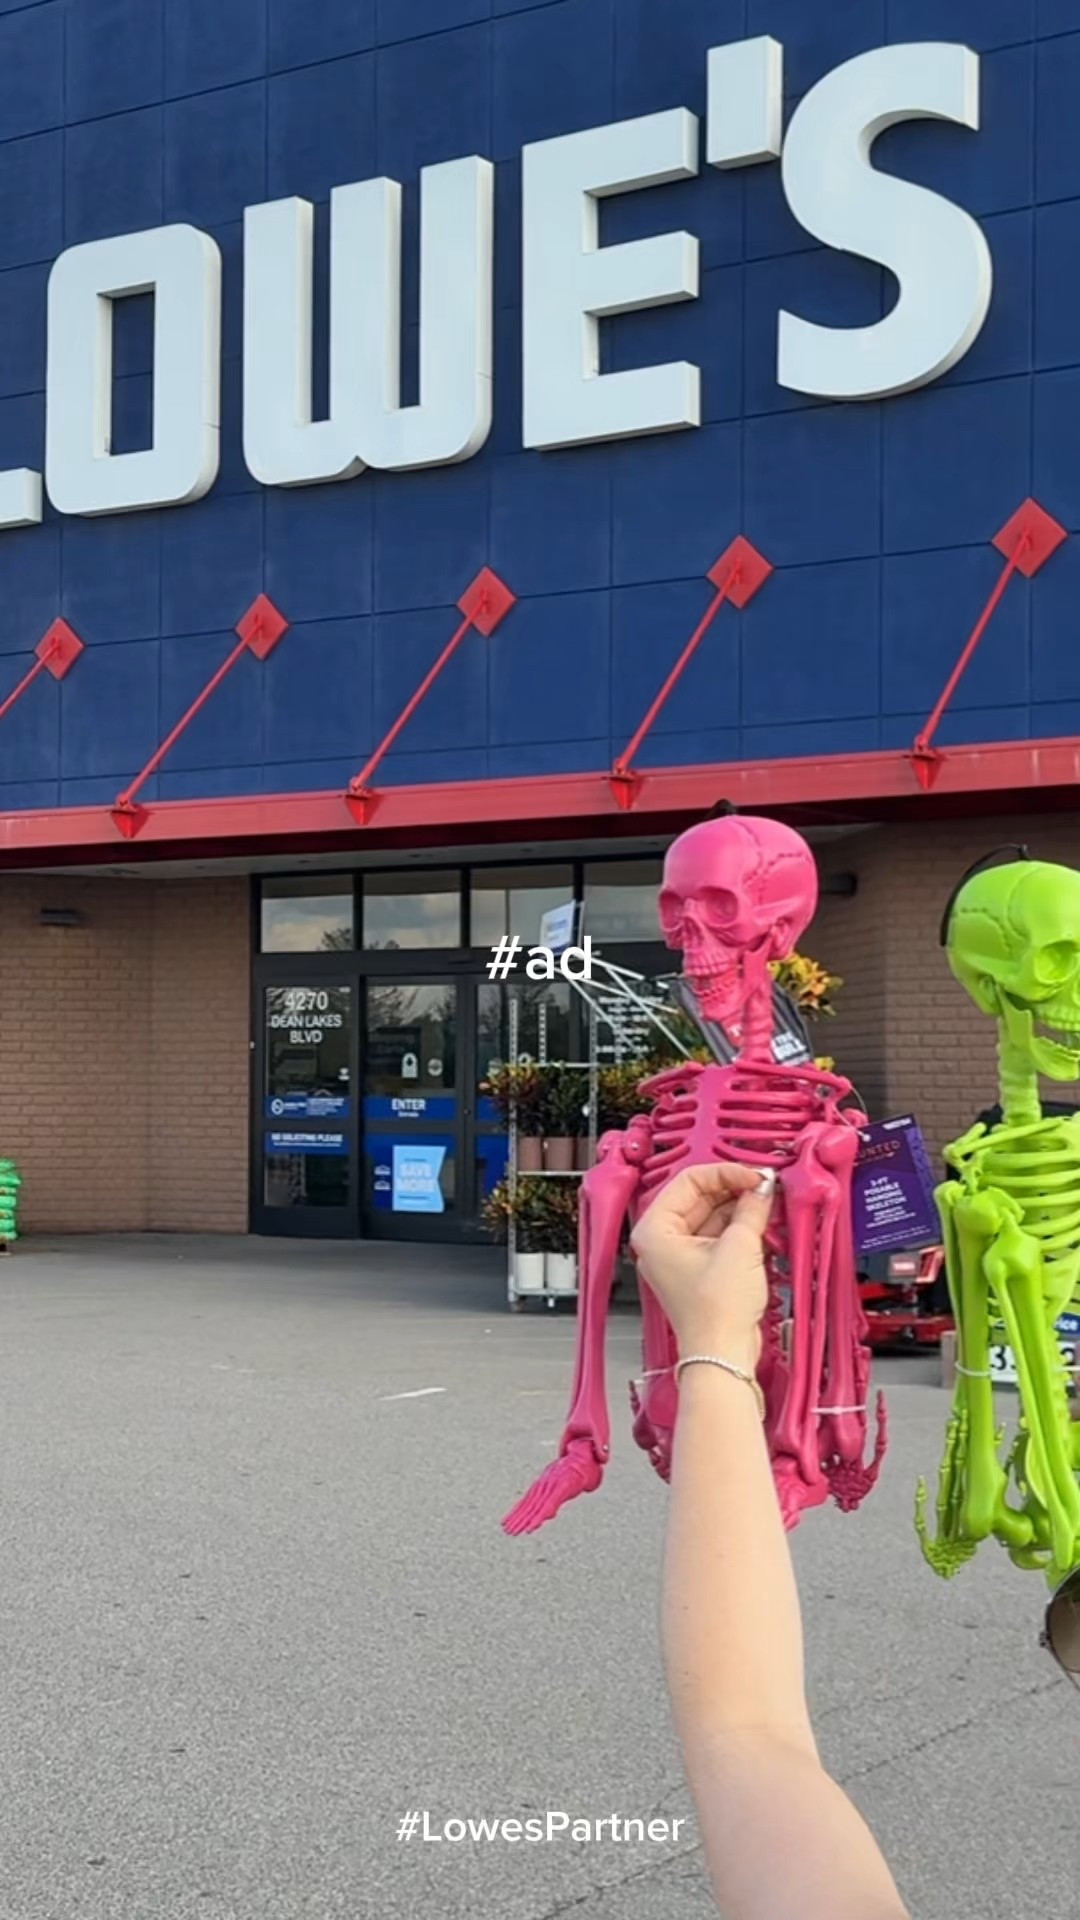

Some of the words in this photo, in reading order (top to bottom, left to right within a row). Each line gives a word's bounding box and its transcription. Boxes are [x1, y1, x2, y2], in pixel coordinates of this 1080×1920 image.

[0, 35, 992, 528] OWE'S
[284, 991, 329, 1011] 4270
[271, 1014, 303, 1028] DEAN
[305, 1014, 343, 1028] LAKES
[289, 1030, 323, 1044] BLVD
[391, 1098, 426, 1111] ENTER
